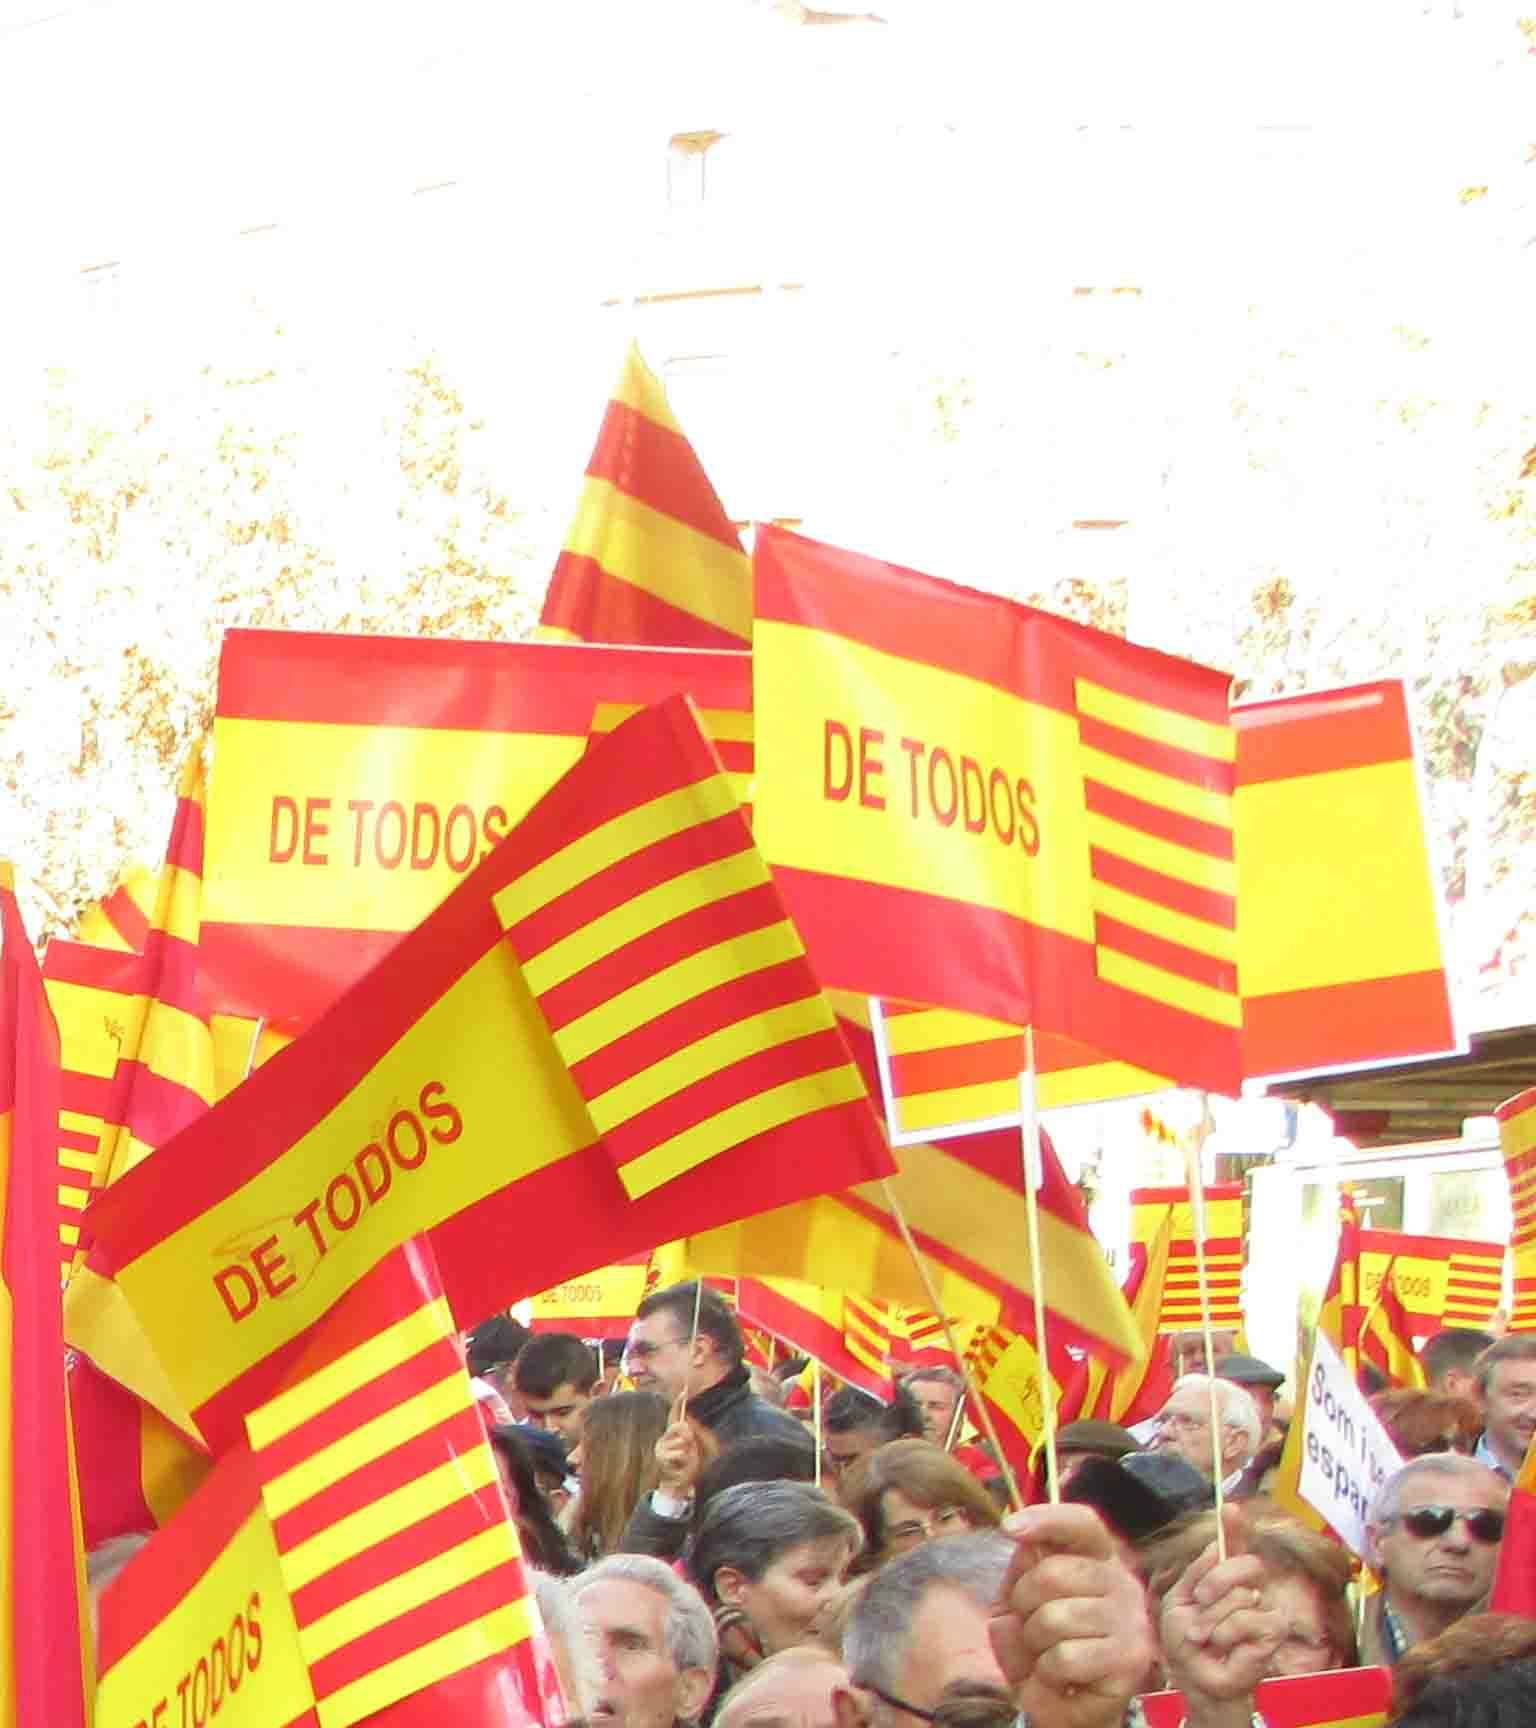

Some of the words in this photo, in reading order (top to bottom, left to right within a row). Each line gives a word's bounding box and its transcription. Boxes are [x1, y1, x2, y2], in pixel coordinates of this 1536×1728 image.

[270, 796, 330, 865] DE
[348, 799, 507, 875] TODOS
[824, 719, 886, 810] DE
[902, 738, 1041, 857] TODOS
[213, 1234, 297, 1322] DE
[293, 1081, 464, 1257] TODOS
[1312, 1362, 1356, 1449] Som
